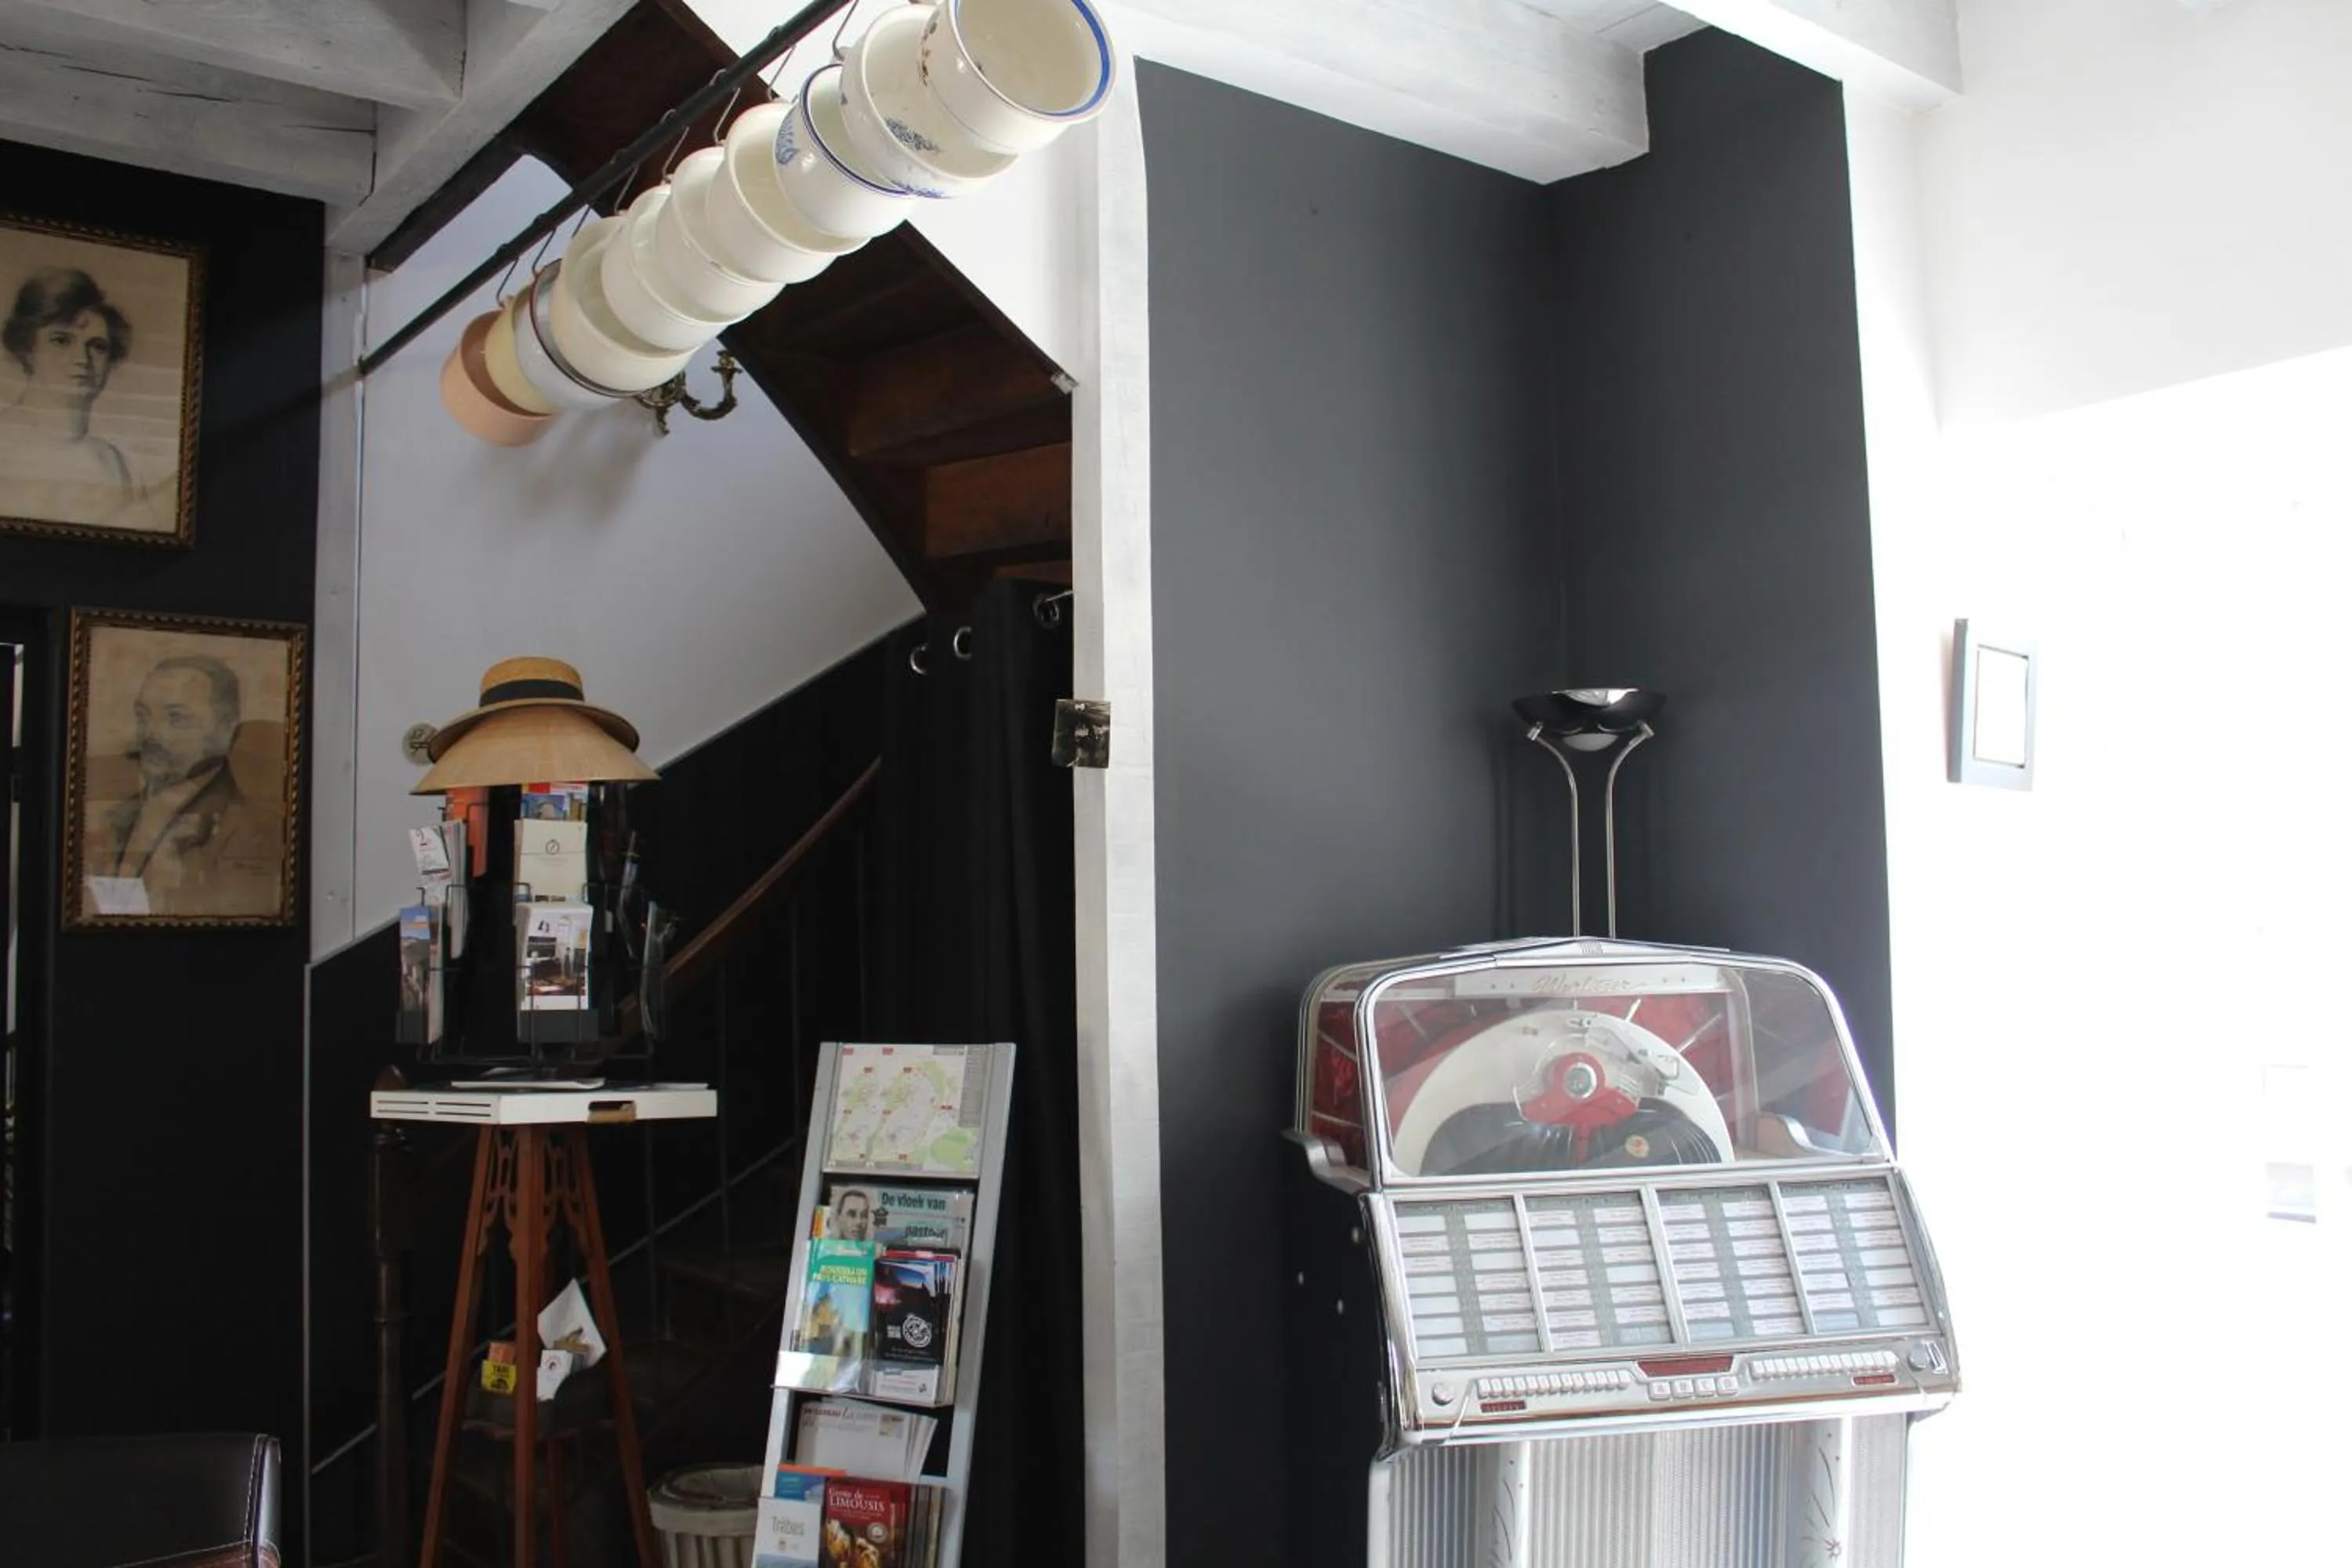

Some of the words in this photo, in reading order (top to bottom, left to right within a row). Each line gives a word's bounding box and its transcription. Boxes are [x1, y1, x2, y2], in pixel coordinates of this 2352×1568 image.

[882, 1192, 895, 1205] De
[897, 1193, 924, 1208] vloek
[927, 1197, 947, 1210] van
[829, 1494, 885, 1512] LIMOUSIS
